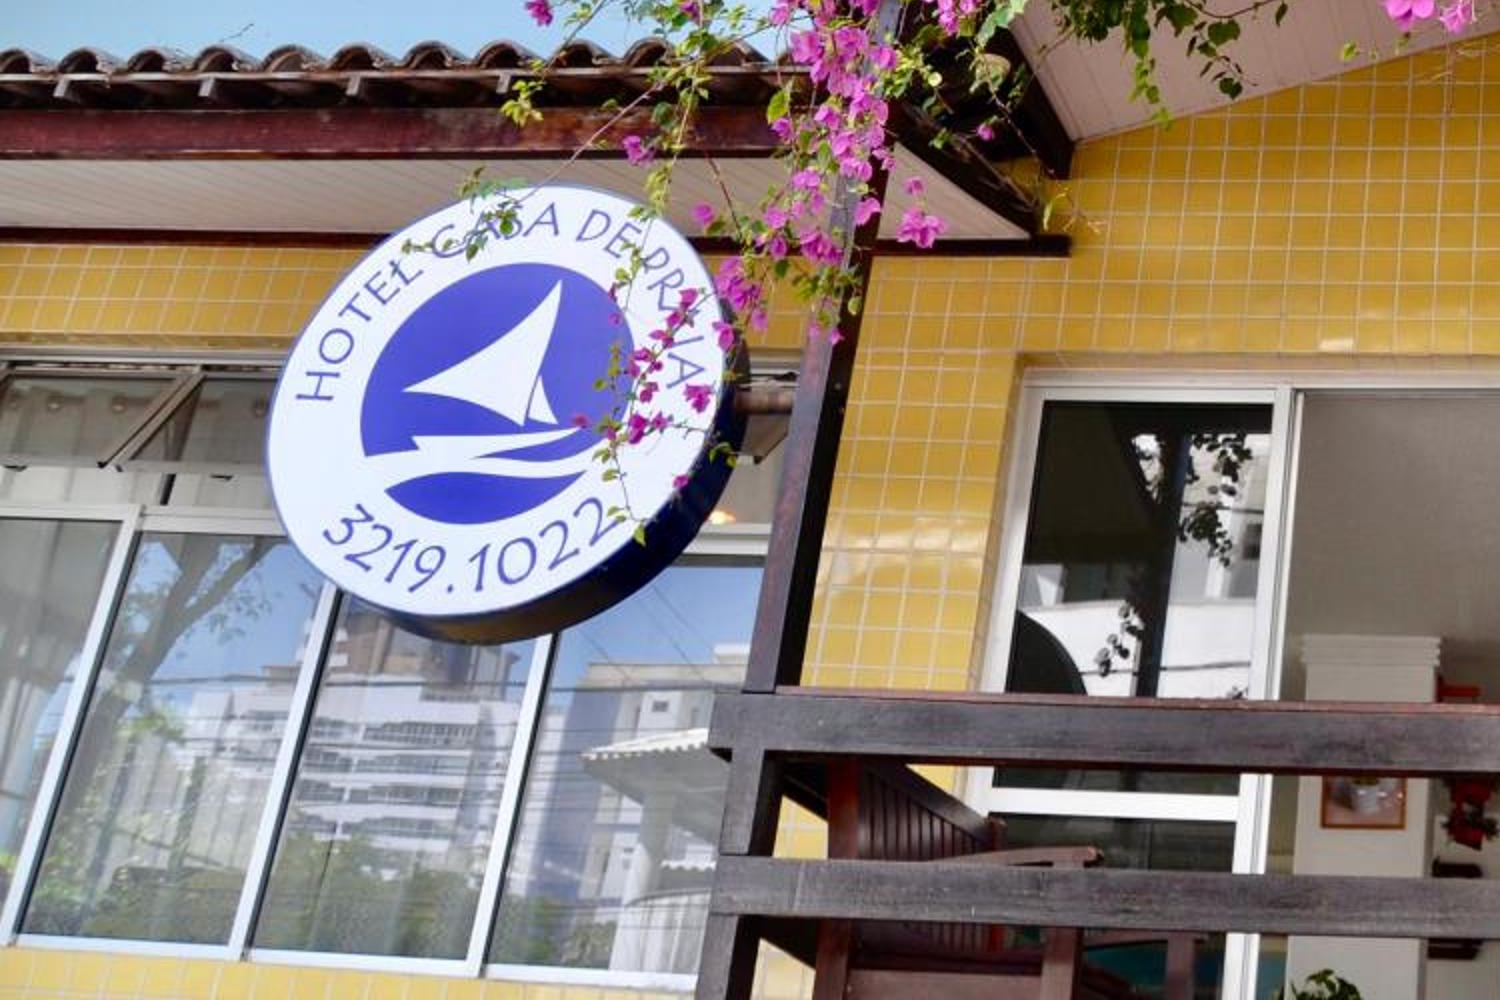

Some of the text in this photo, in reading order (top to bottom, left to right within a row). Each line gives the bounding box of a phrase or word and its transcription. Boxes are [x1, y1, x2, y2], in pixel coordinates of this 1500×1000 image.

[295, 259, 425, 402] HOTEL
[575, 208, 643, 259] DE
[322, 496, 627, 593] 3219.1022
